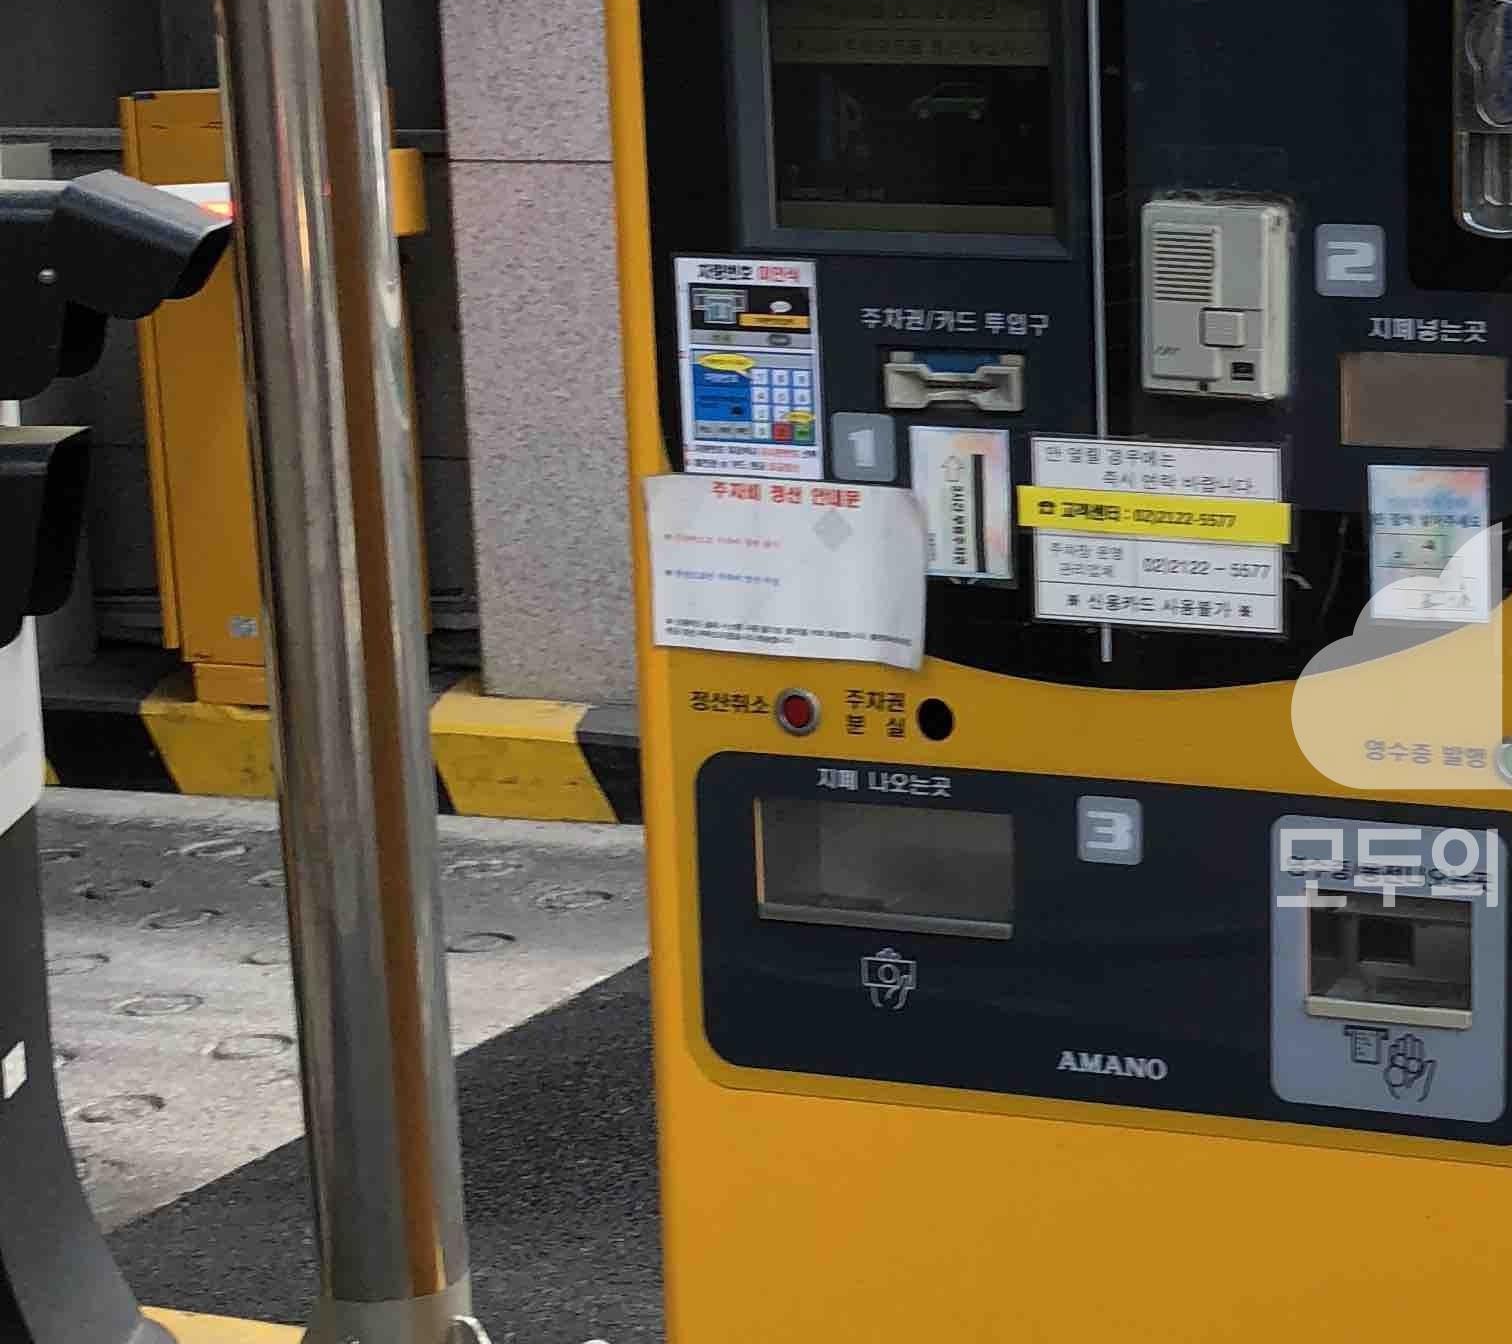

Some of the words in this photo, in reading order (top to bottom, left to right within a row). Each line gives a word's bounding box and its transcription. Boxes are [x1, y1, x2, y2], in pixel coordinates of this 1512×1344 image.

[1327, 241, 1376, 281] 2
[860, 307, 977, 333] 주차권/카드
[984, 312, 1049, 337] 투입구
[1368, 316, 1488, 344] 지폐넣는곳
[847, 429, 877, 468] 1
[816, 767, 858, 792] 지폐
[868, 770, 952, 798] 나오는곳
[1086, 810, 1133, 851] 3
[1058, 1050, 1168, 1081] AMANO
